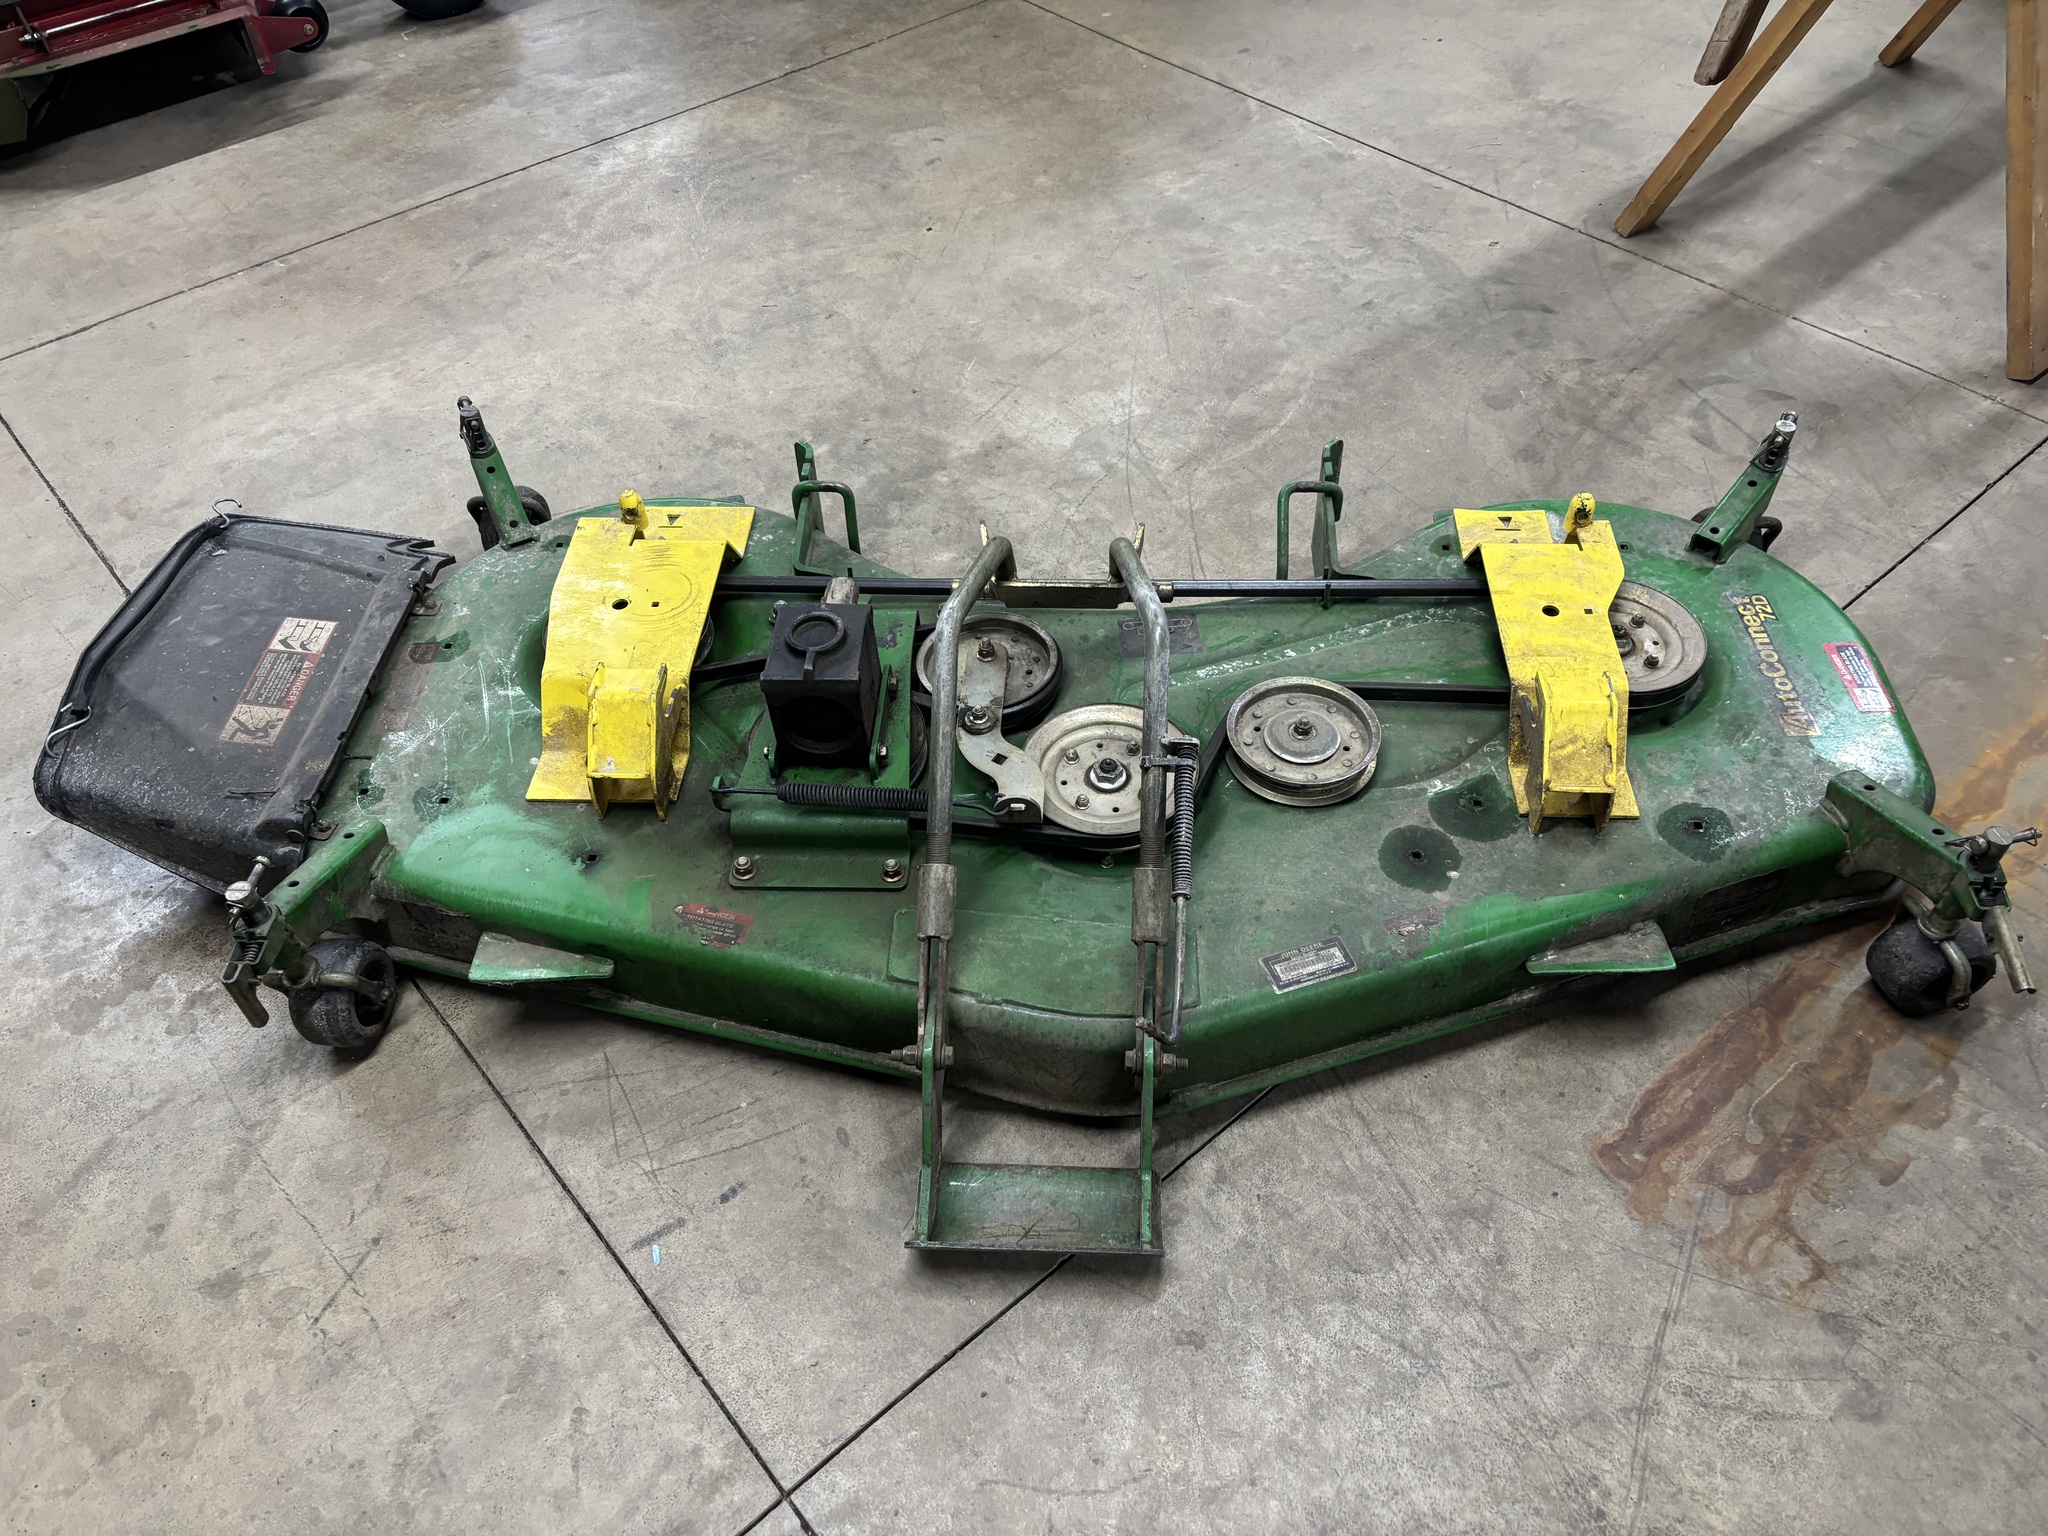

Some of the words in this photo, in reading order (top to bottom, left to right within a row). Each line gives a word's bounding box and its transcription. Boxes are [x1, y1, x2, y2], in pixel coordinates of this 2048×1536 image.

[1749, 594, 1777, 621] 72D
[1727, 596, 1822, 735] AutoConnect
[1830, 653, 1847, 674] DANGER
[286, 668, 310, 701] DANGER
[1281, 949, 1299, 957] JOHN
[1299, 942, 1322, 950] DEERE
